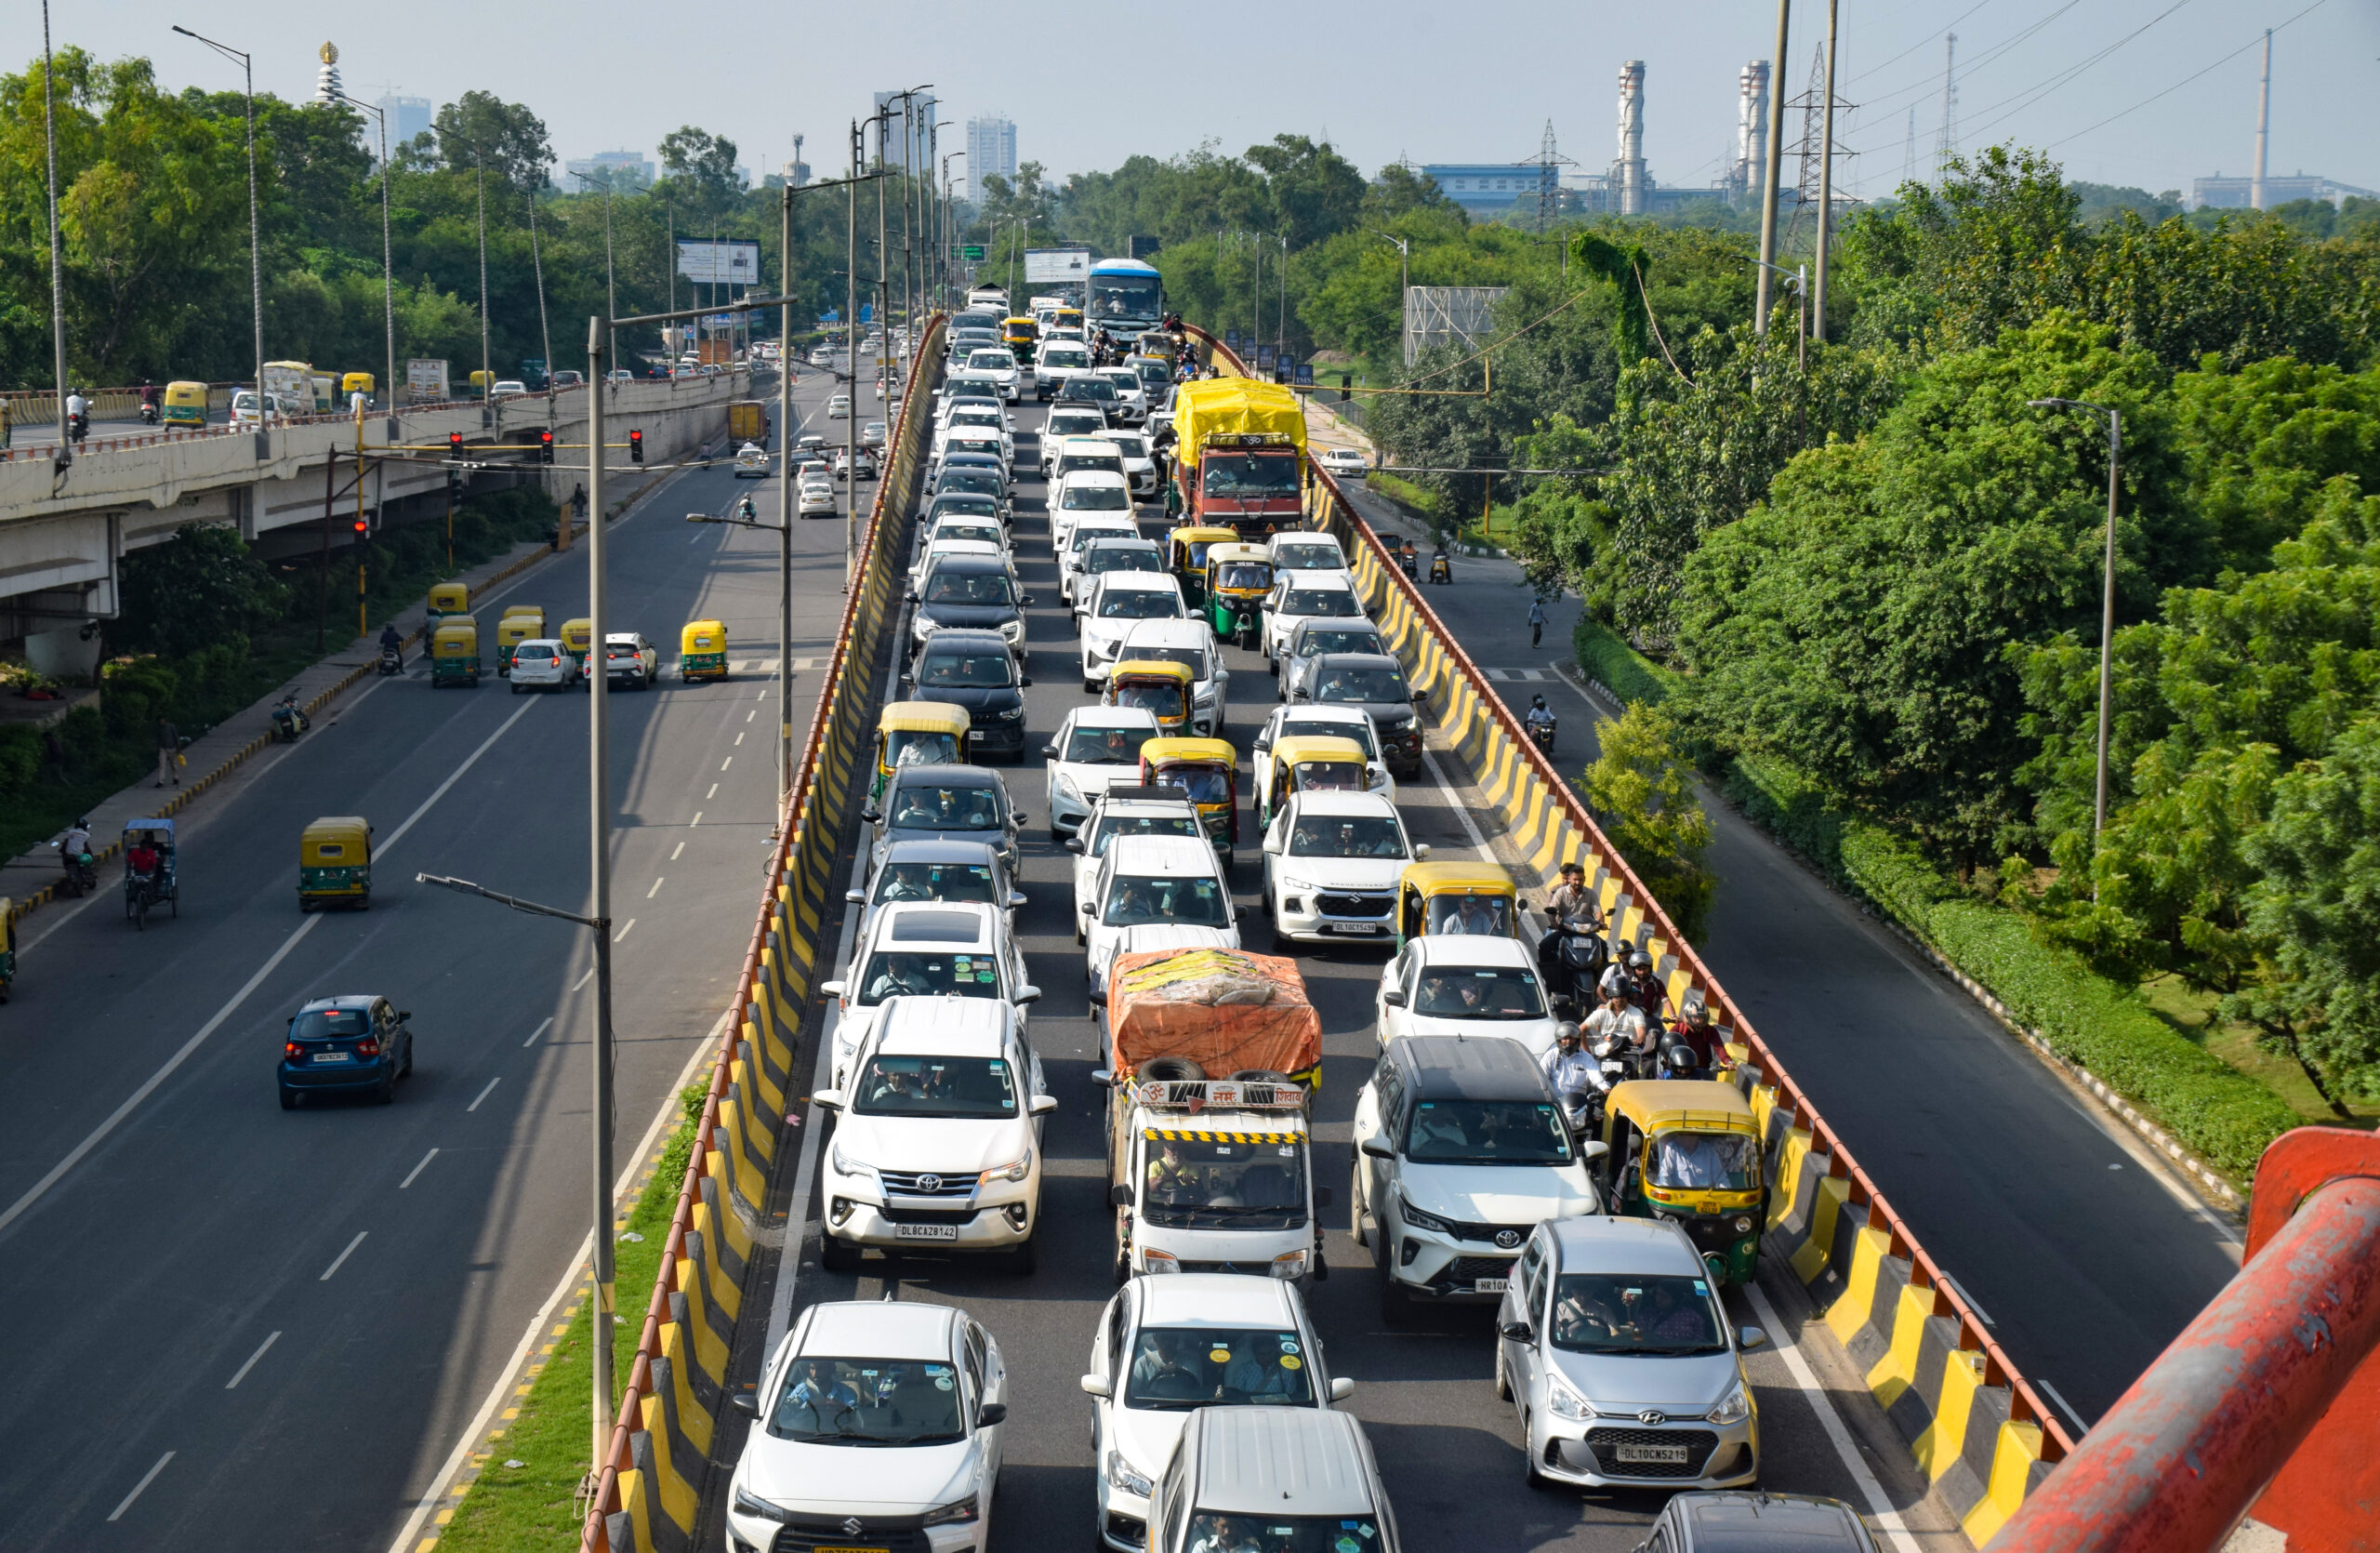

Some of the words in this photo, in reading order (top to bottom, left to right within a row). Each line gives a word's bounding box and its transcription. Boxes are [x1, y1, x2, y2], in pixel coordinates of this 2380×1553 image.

[1275, 1087, 1302, 1103] शिवाय
[902, 1226, 954, 1237] DL8CAZ8142
[1624, 1448, 1686, 1460] DL10CN5219
